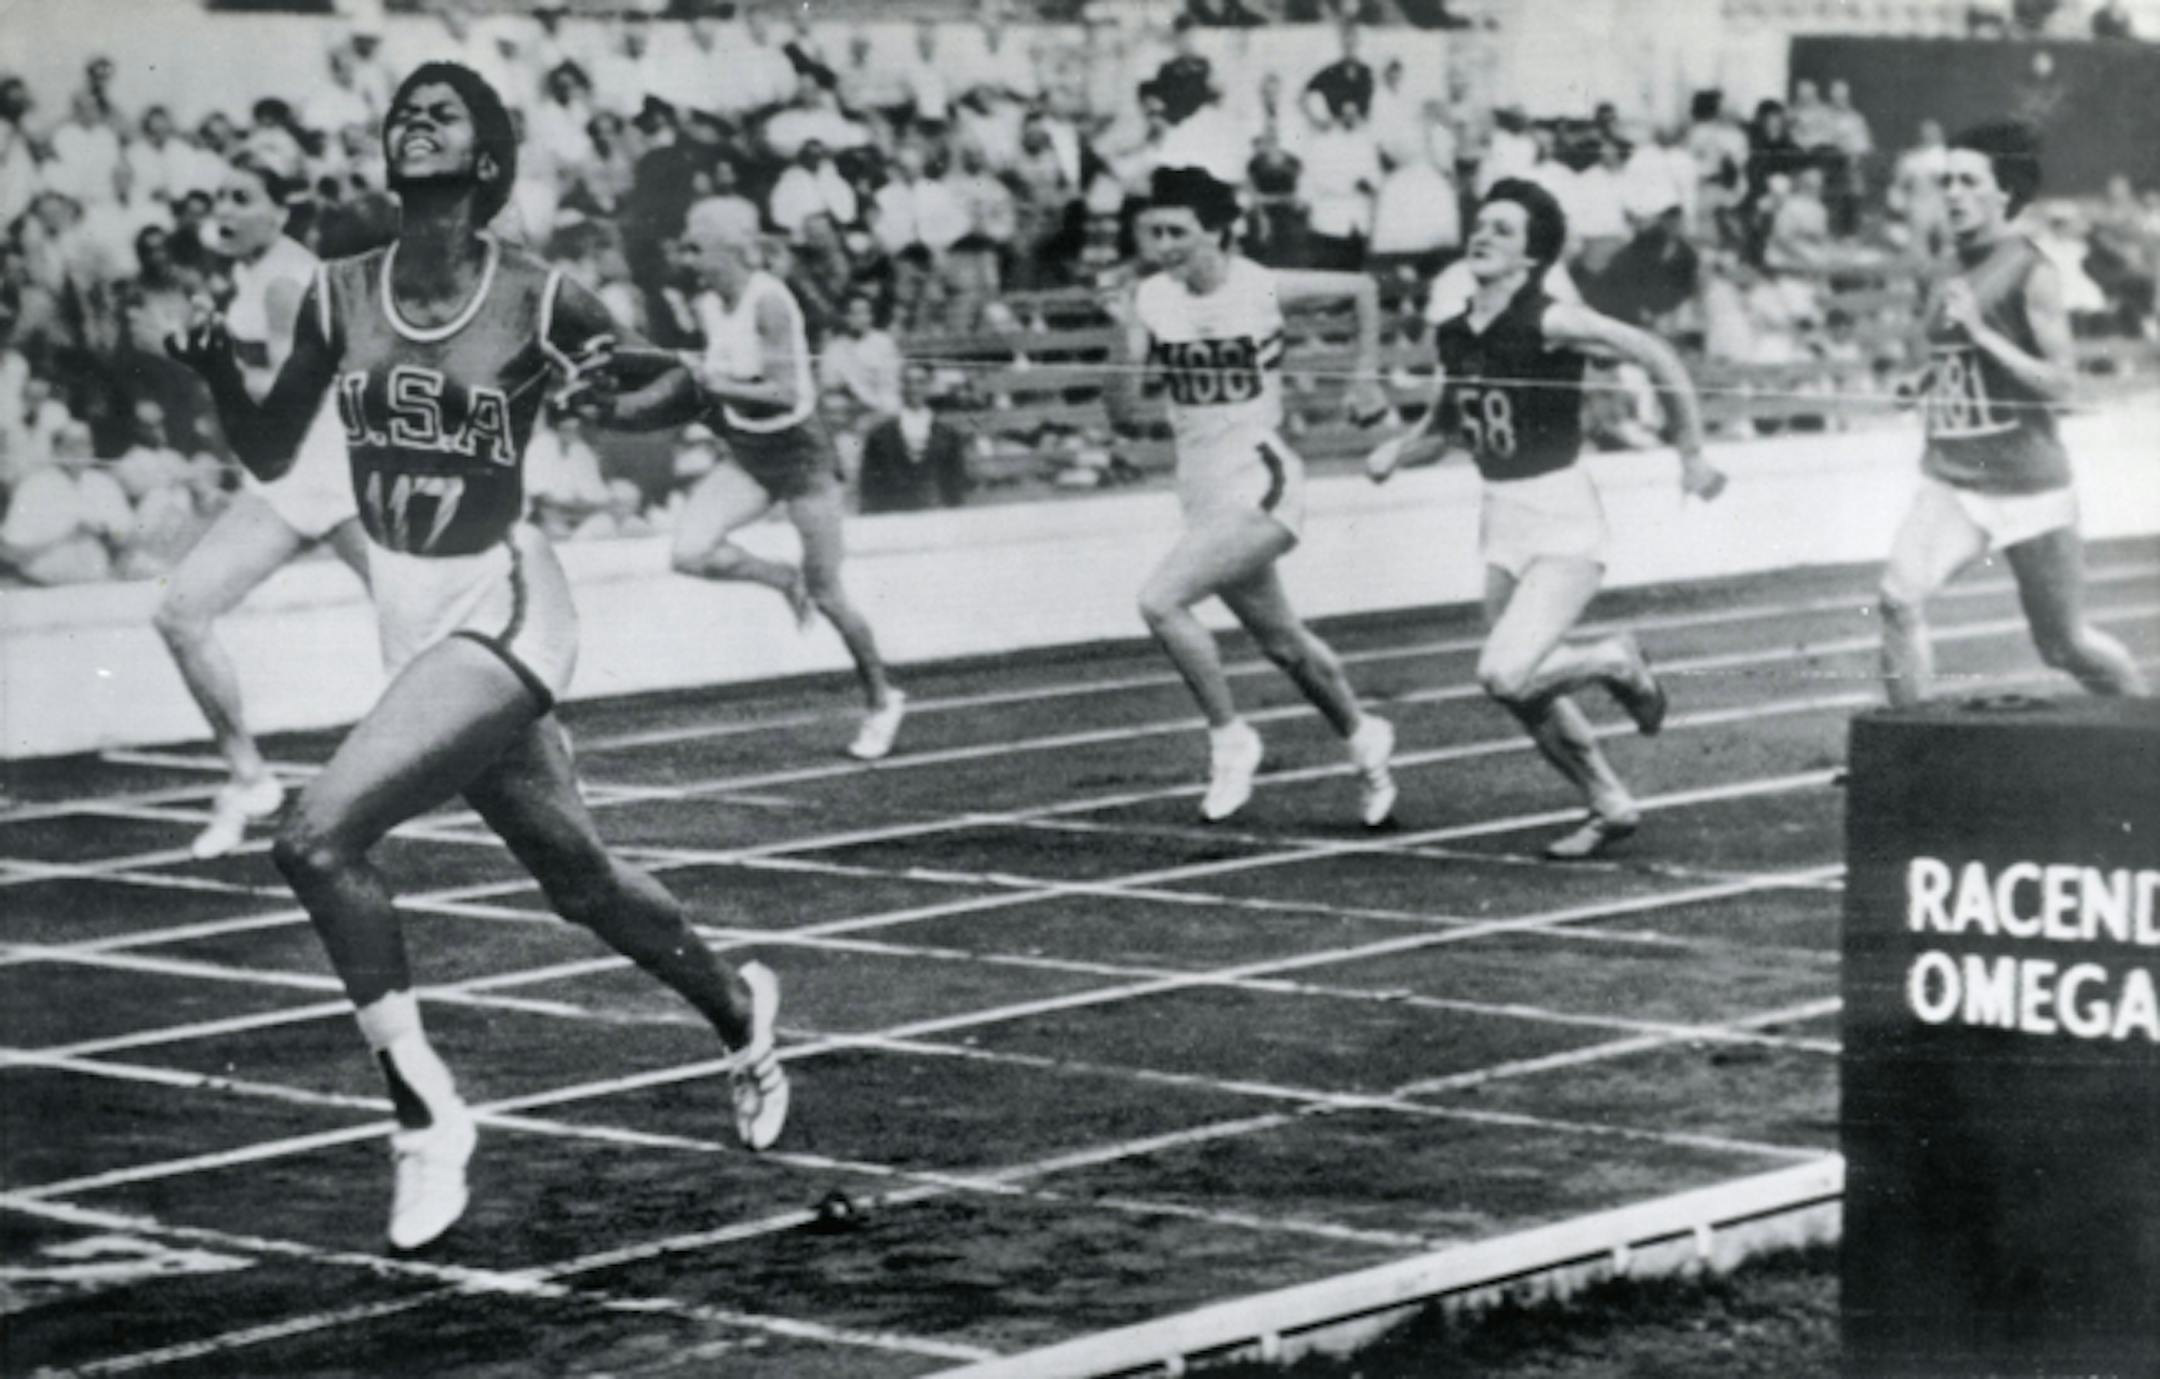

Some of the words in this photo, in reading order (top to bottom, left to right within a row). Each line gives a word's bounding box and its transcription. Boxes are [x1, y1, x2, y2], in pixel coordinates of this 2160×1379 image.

[1457, 388, 1517, 458] 58
[365, 470, 465, 552] 117
[1907, 950, 2160, 1041] OMEGA
